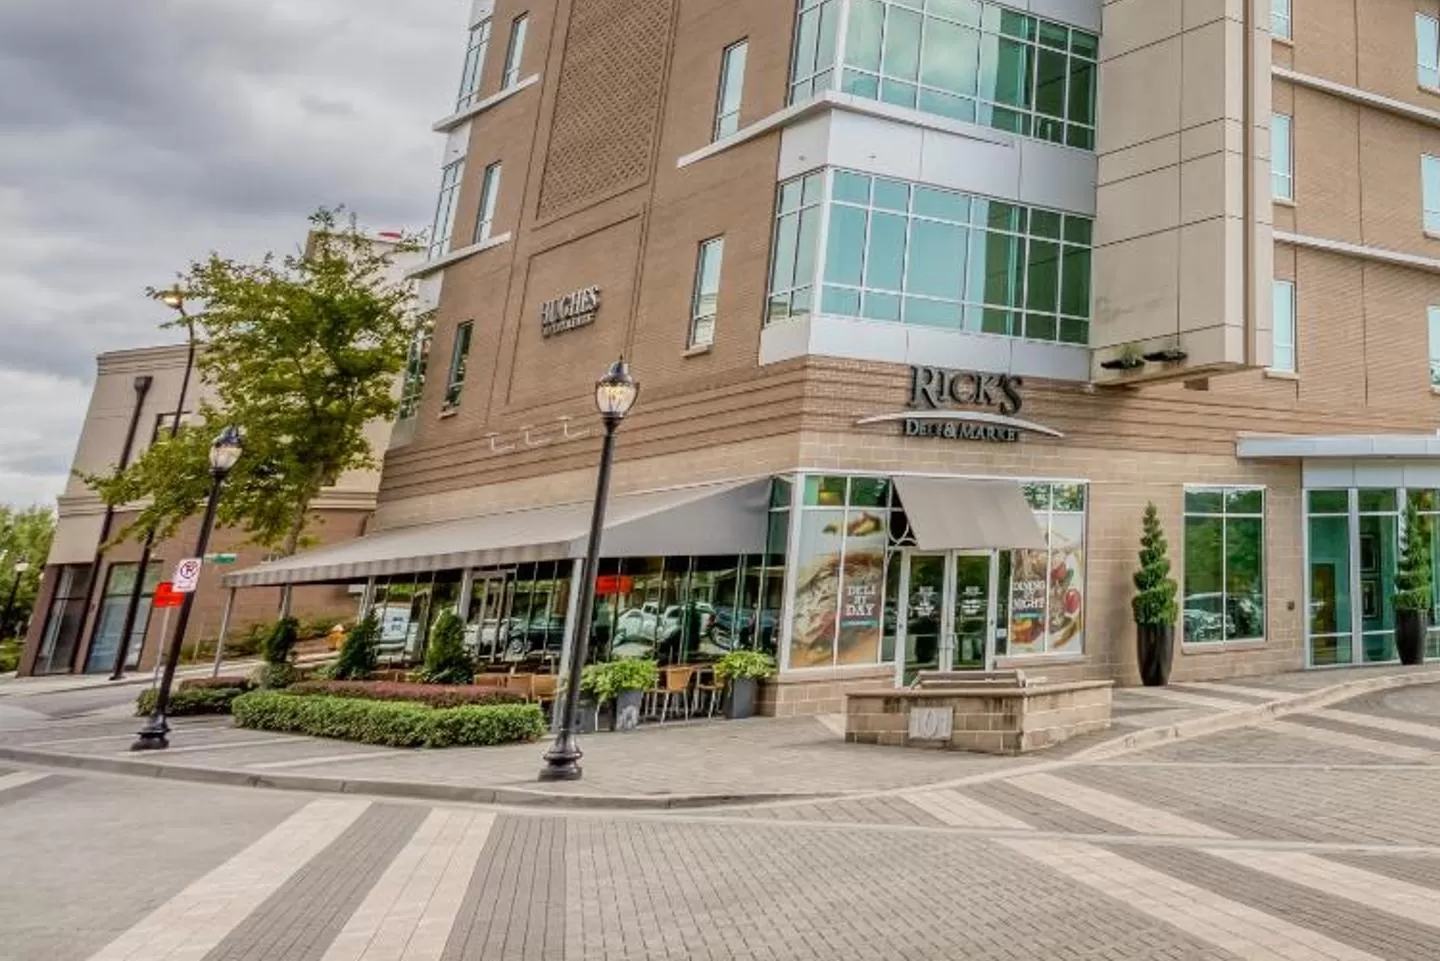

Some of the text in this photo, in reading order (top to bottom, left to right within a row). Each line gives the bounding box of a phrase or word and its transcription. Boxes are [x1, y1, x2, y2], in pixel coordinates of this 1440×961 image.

[908, 365, 1022, 415] RICK'S
[943, 421, 957, 439] &
[845, 603, 876, 616] DAY
